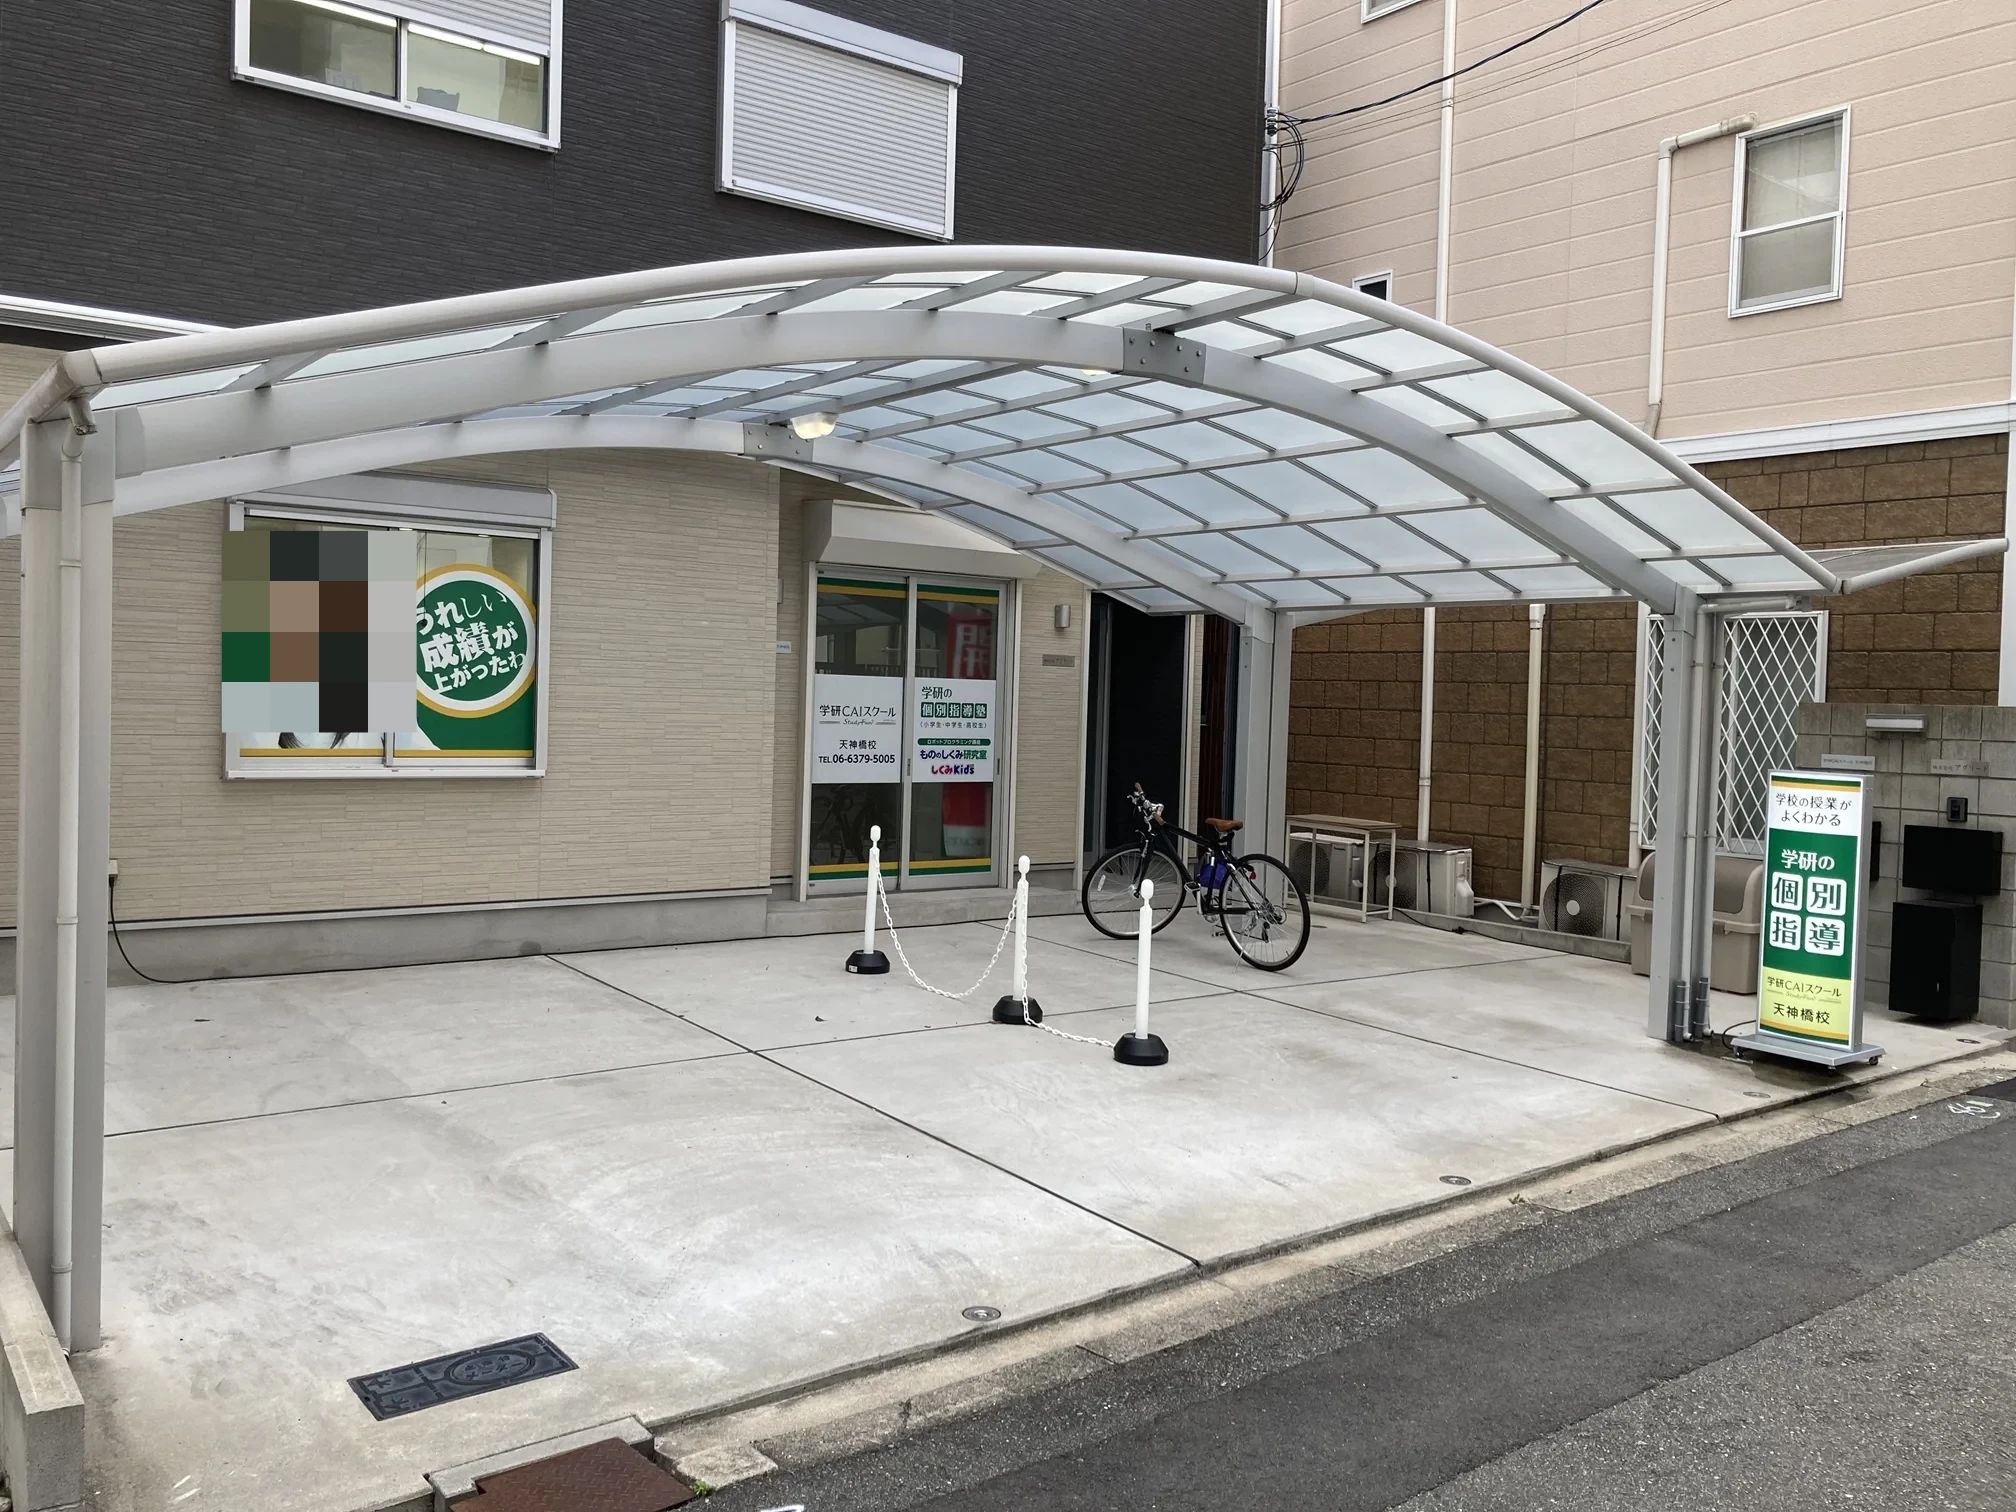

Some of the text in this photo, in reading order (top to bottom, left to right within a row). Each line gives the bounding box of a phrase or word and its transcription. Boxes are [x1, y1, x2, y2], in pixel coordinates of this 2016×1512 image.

[416, 591, 507, 635] うれしい
[420, 621, 519, 673] 成績が
[434, 651, 527, 694] 上がったわ
[922, 686, 952, 700] 学研の
[819, 705, 896, 717] 学研CAIスクール
[921, 702, 987, 719] 個別指導塾
[839, 739, 877, 750] 天神橋校
[920, 749, 987, 760] もののしくみ研究室
[931, 764, 975, 775] しくみKids
[1776, 793, 1852, 811] 学校の授業が
[1781, 810, 1841, 827] よくわかる
[1781, 848, 1836, 872] 学研の
[1767, 976, 1842, 997] 学研CAIスクール
[1773, 1002, 1830, 1025] 天神橋校
